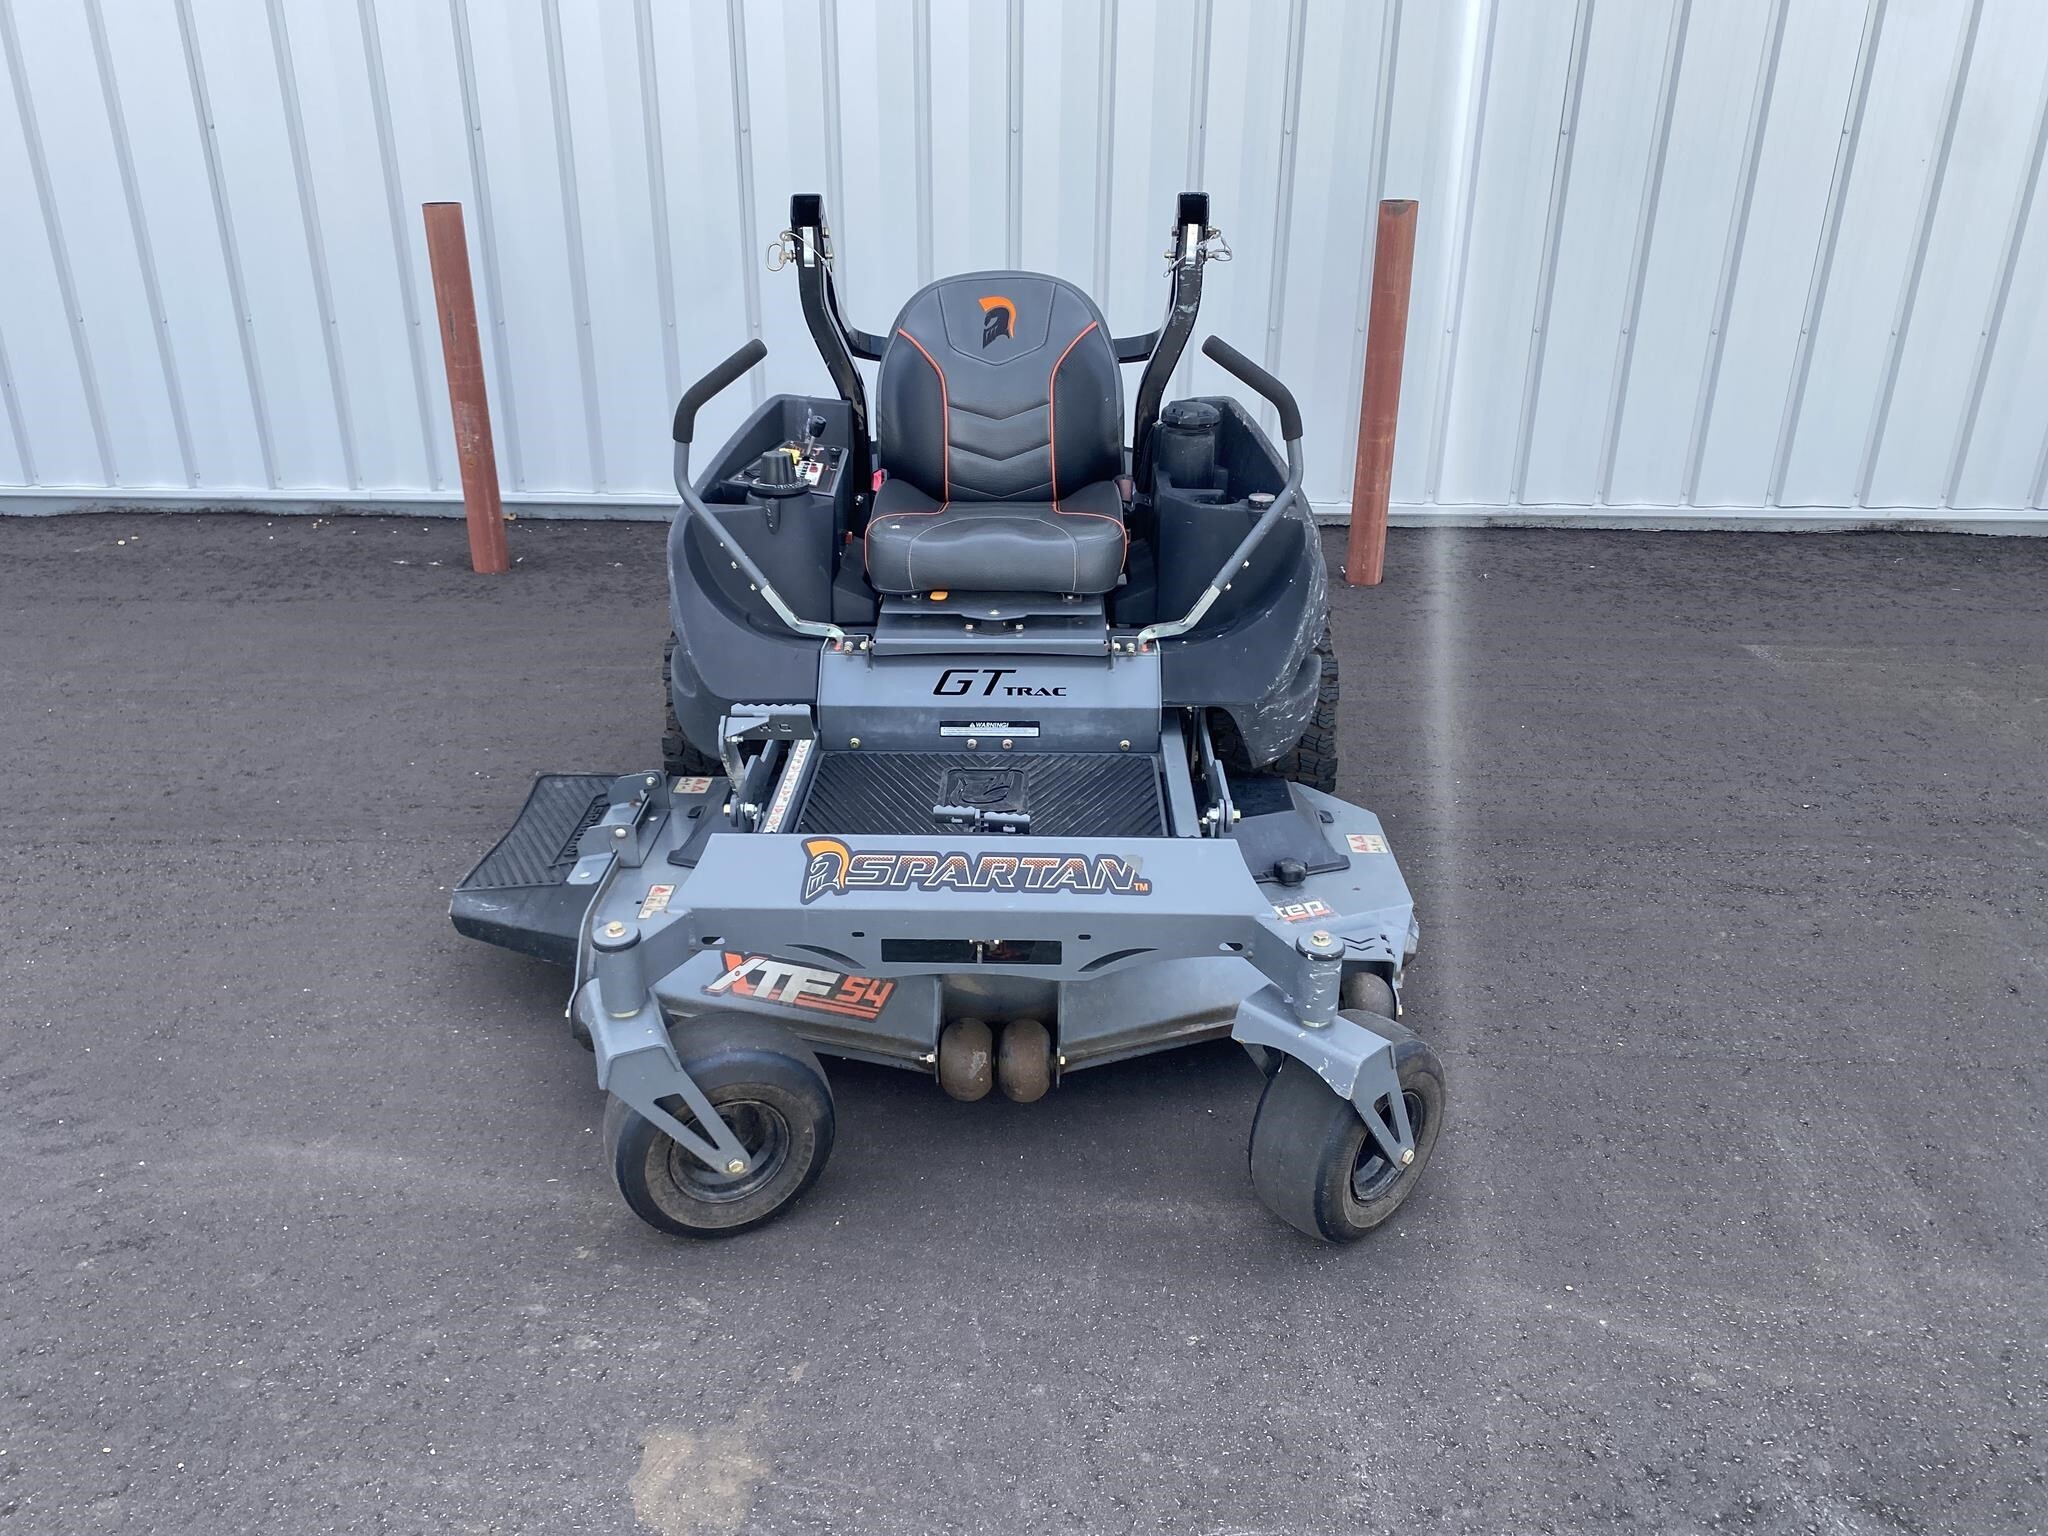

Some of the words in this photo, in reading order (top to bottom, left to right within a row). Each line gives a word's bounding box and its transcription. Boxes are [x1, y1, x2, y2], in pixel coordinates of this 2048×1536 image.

[933, 669, 1017, 696] GT
[1003, 687, 1067, 697] TRAC
[845, 855, 1135, 889] SPARTAN
[706, 953, 841, 1003] XTF
[836, 975, 894, 1007] 54
